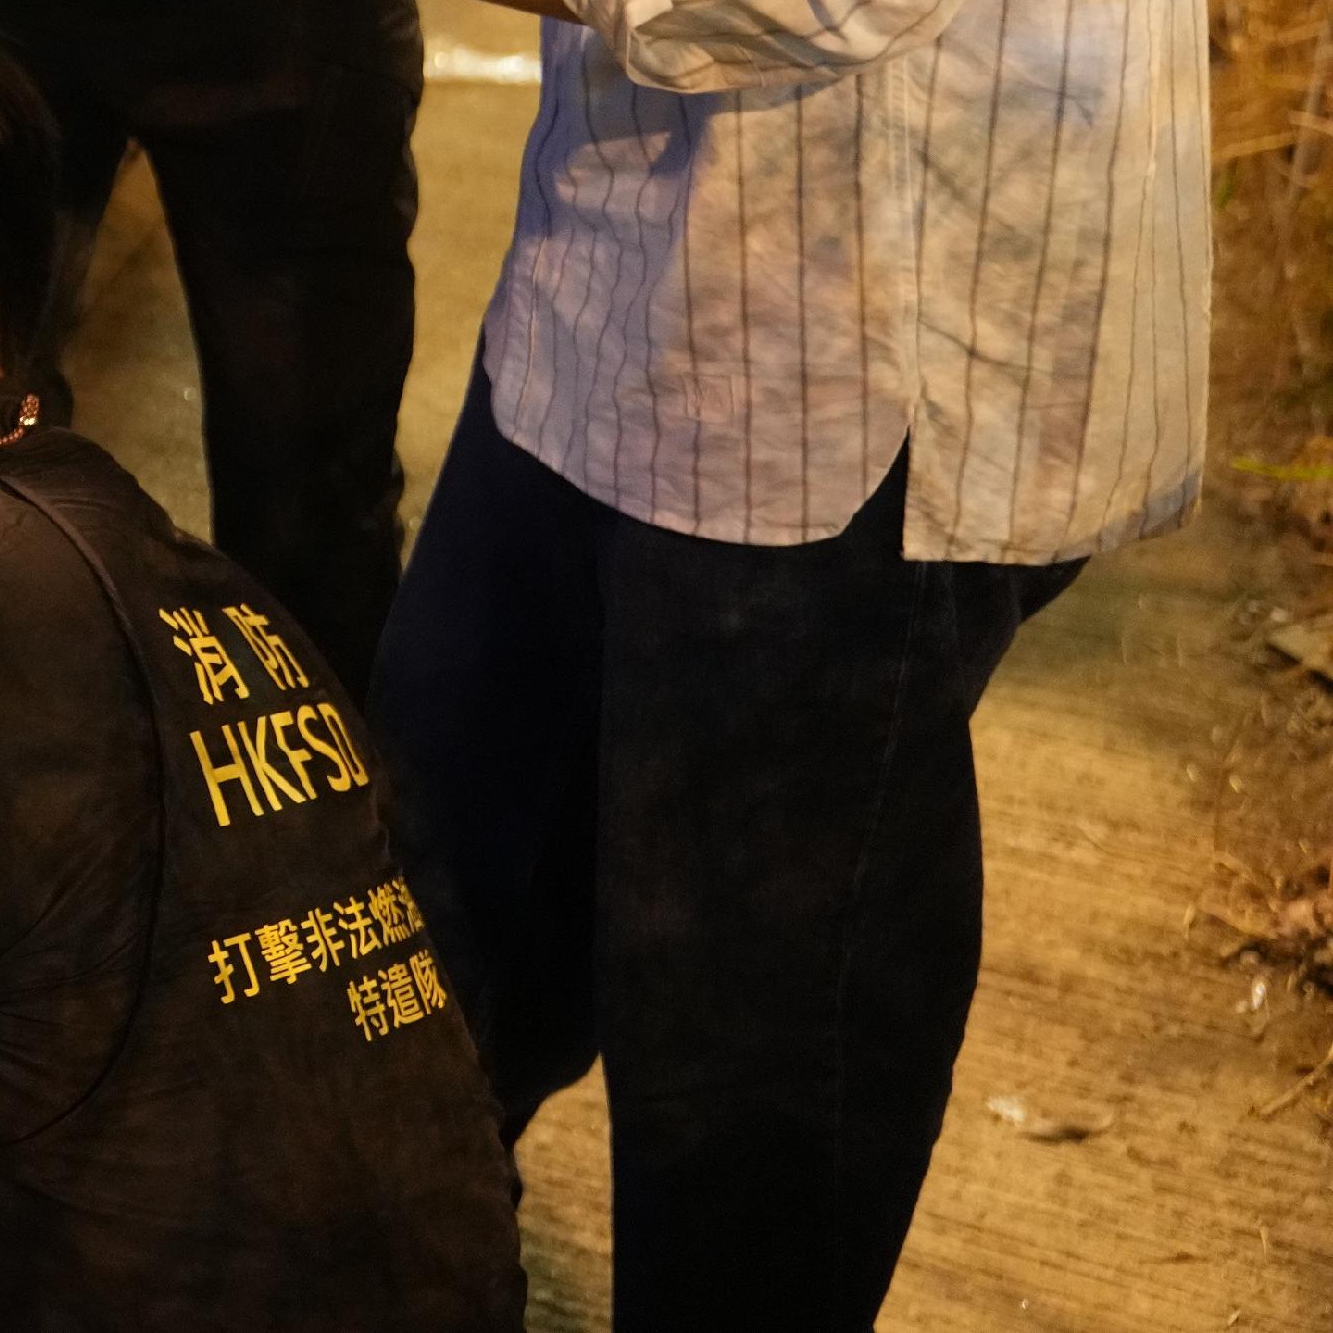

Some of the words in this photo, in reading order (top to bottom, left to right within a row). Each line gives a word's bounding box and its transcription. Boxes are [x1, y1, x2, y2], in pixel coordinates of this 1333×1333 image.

[158, 602, 310, 705] 消防
[190, 702, 370, 827] HKFSD
[347, 949, 447, 1042] 特遣隊
